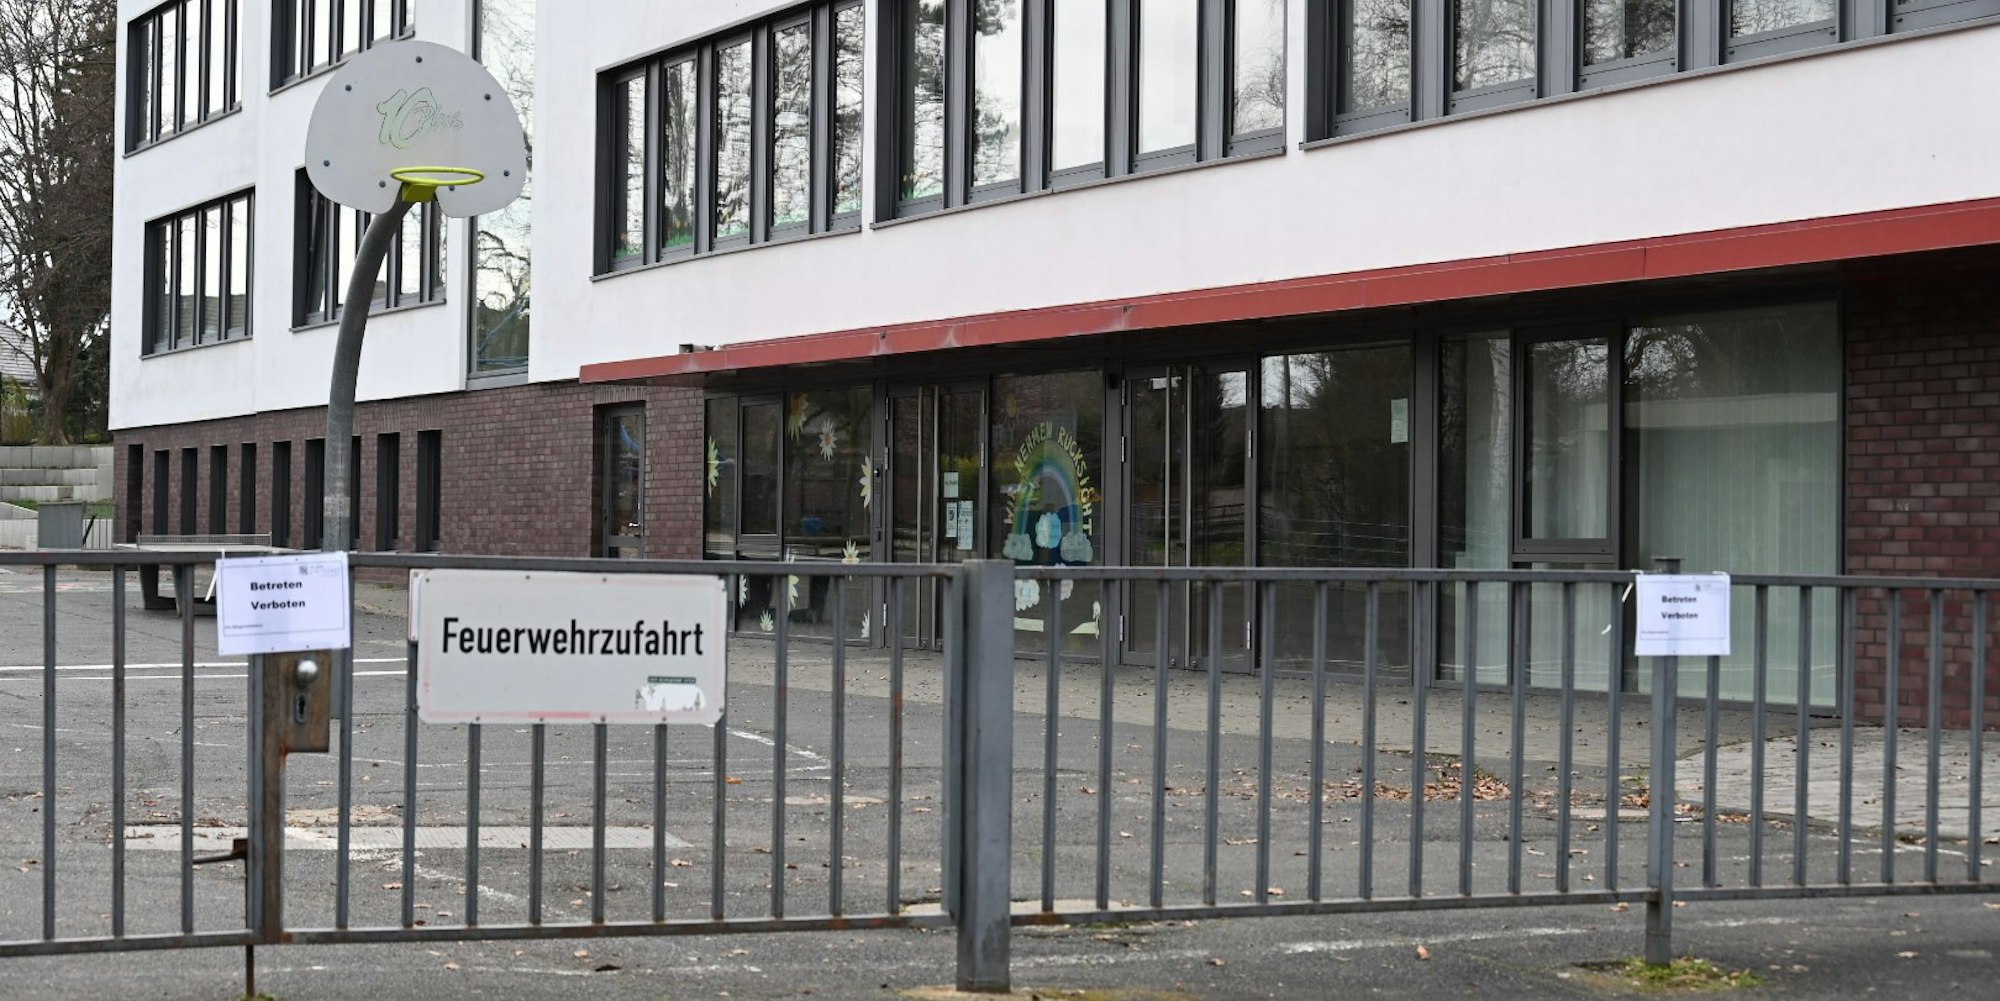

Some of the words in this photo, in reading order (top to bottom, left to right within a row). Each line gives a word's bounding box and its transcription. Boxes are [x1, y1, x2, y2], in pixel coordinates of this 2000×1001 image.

[376, 87, 437, 150] 10
[1015, 421, 1053, 473] NEHMEN
[250, 581, 303, 591] Betreten
[1661, 595, 1697, 603] Betreten
[251, 600, 306, 610] Verboten
[1661, 612, 1698, 620] Verboten
[441, 617, 704, 656] Feuerwehrzufahrt
